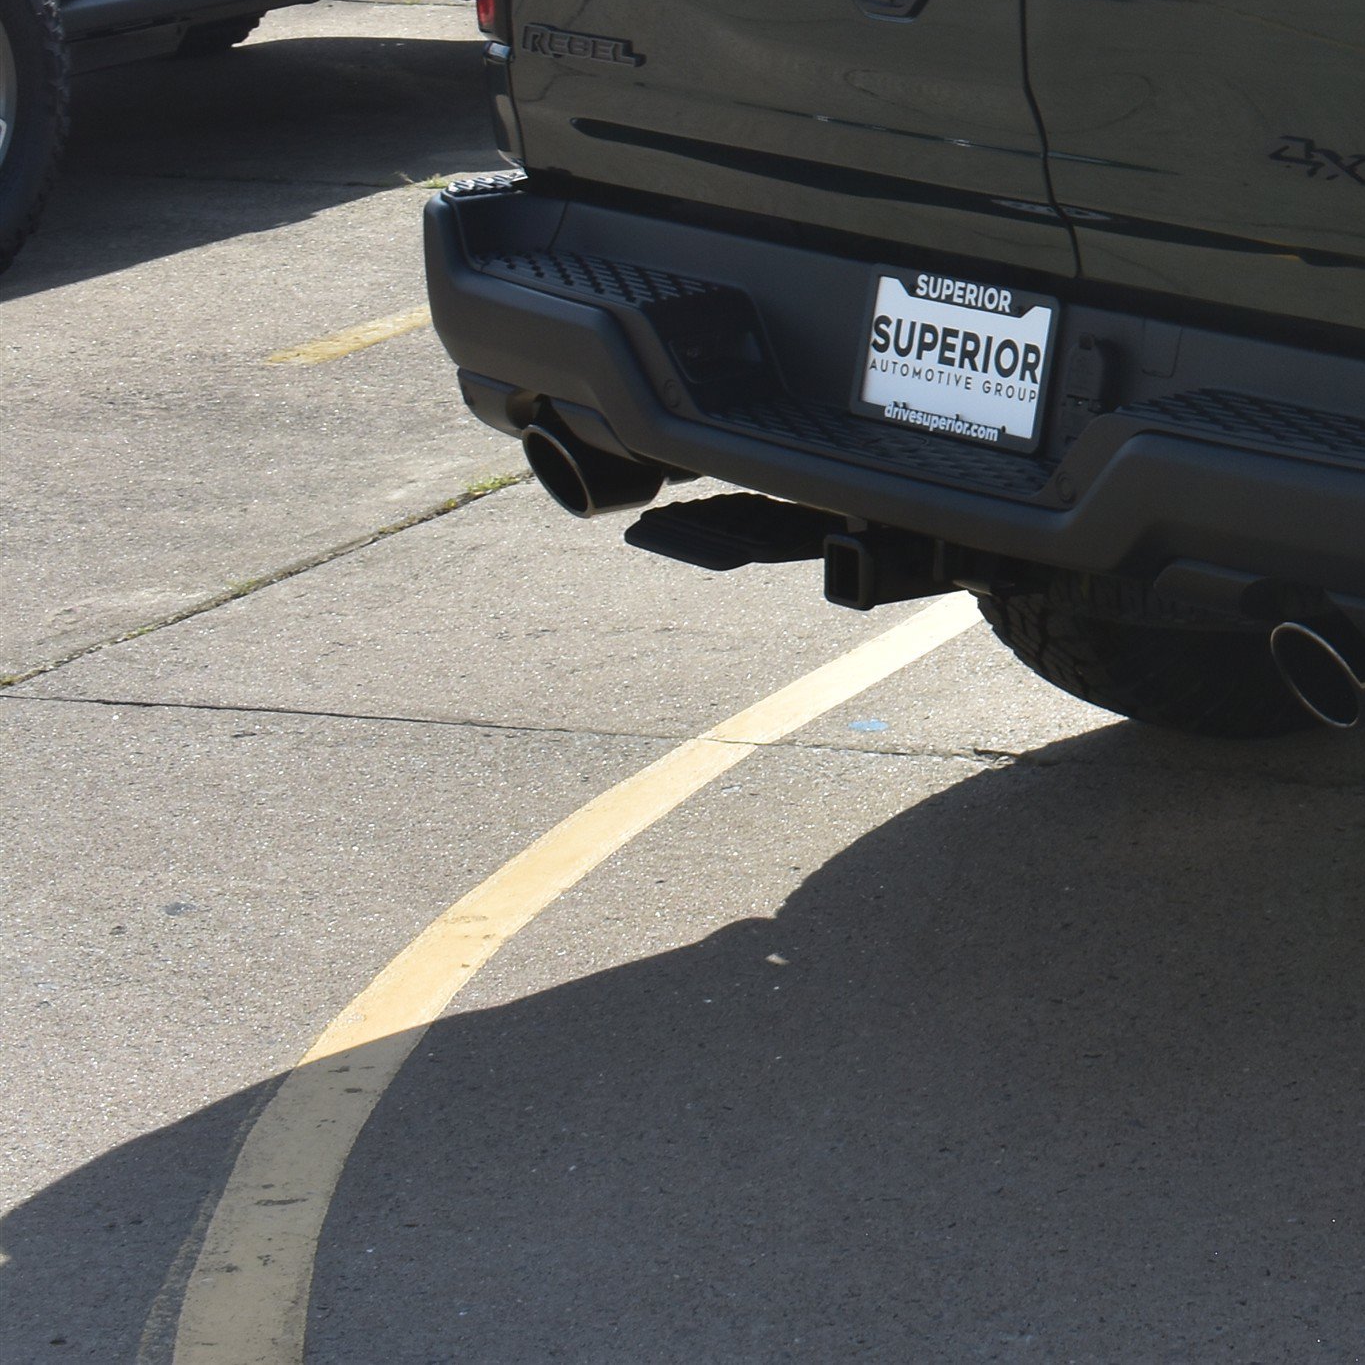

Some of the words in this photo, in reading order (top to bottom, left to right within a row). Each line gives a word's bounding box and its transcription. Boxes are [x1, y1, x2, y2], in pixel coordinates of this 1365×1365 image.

[522, 23, 646, 67] REBEL
[915, 274, 1012, 313] SUPERIOR
[870, 315, 1041, 384] SUPERIOR
[869, 359, 973, 390] AUTOMOTIVE
[982, 380, 1037, 403] GROUP
[884, 401, 999, 442] drivesuperior.com
